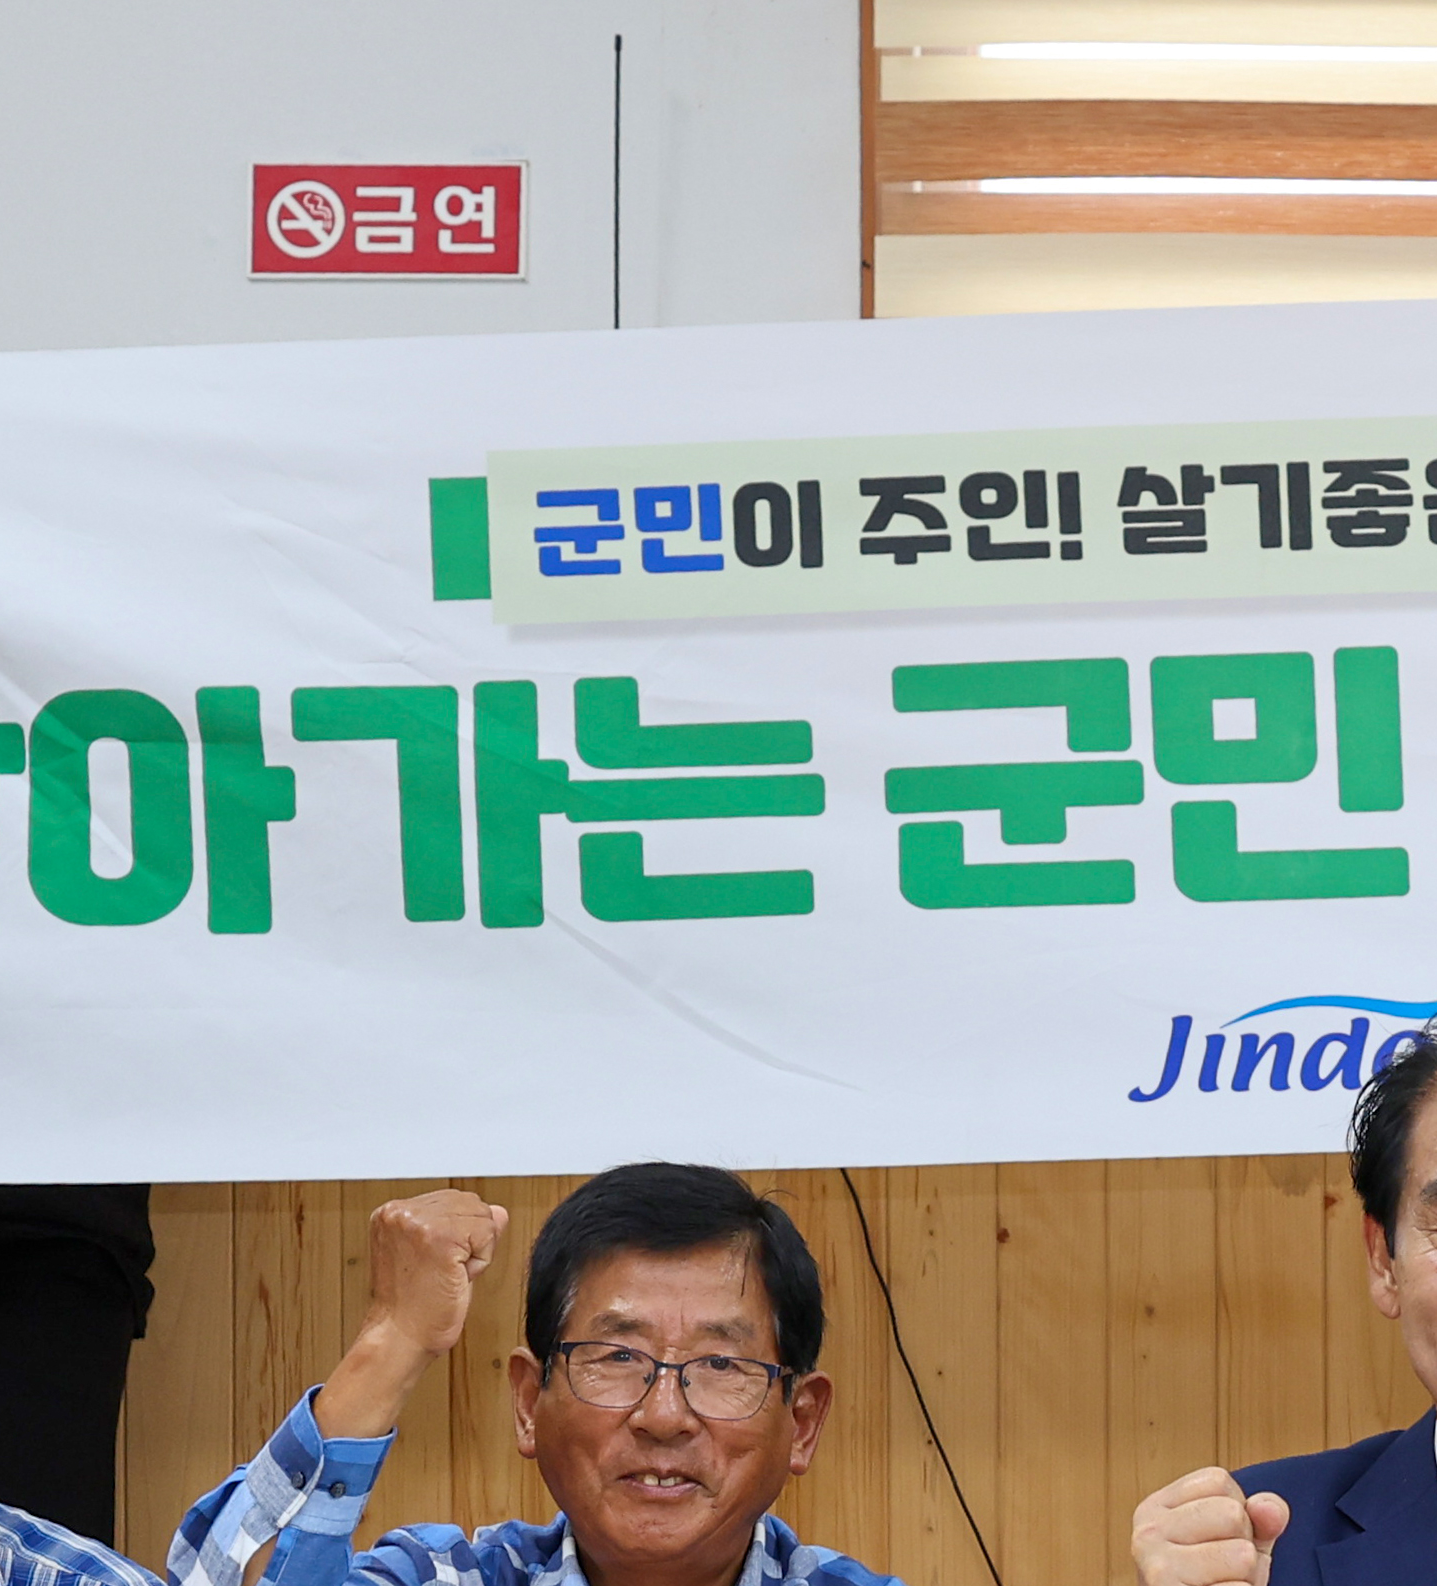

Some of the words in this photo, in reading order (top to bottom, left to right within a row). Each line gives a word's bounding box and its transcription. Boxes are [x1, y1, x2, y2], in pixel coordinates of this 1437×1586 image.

[352, 185, 496, 254] 금연
[533, 480, 824, 578] 군민이
[858, 470, 1084, 566] 주인!
[883, 645, 1411, 911] 군민
